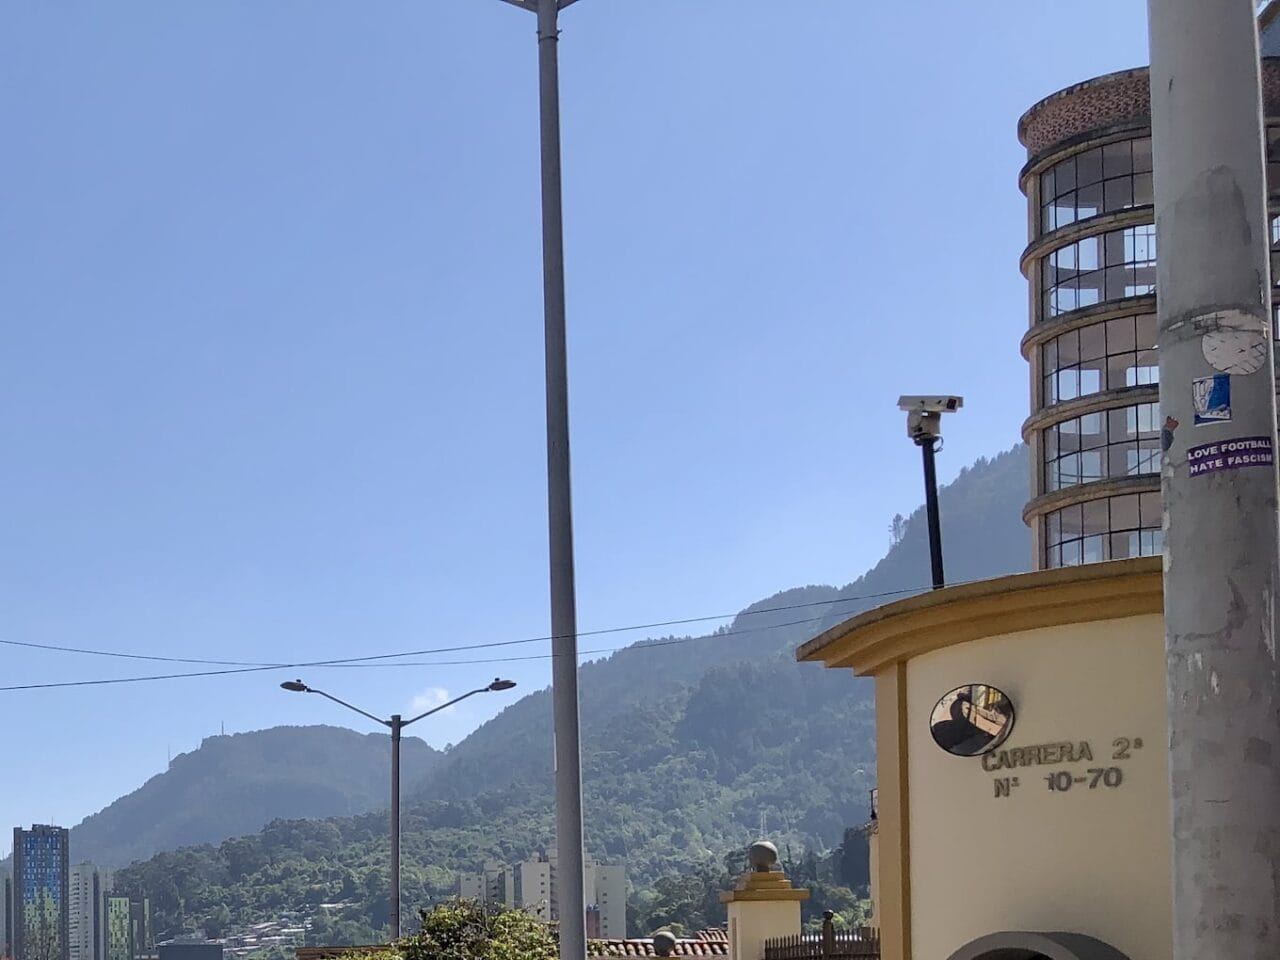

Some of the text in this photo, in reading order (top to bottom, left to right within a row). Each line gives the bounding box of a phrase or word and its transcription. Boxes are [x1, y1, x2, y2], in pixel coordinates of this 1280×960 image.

[1187, 440, 1272, 460] LOVE FOOTBALL
[1189, 458, 1224, 474] HATE
[981, 740, 1094, 772] CARRERA
[1043, 766, 1124, 792] 10-70
